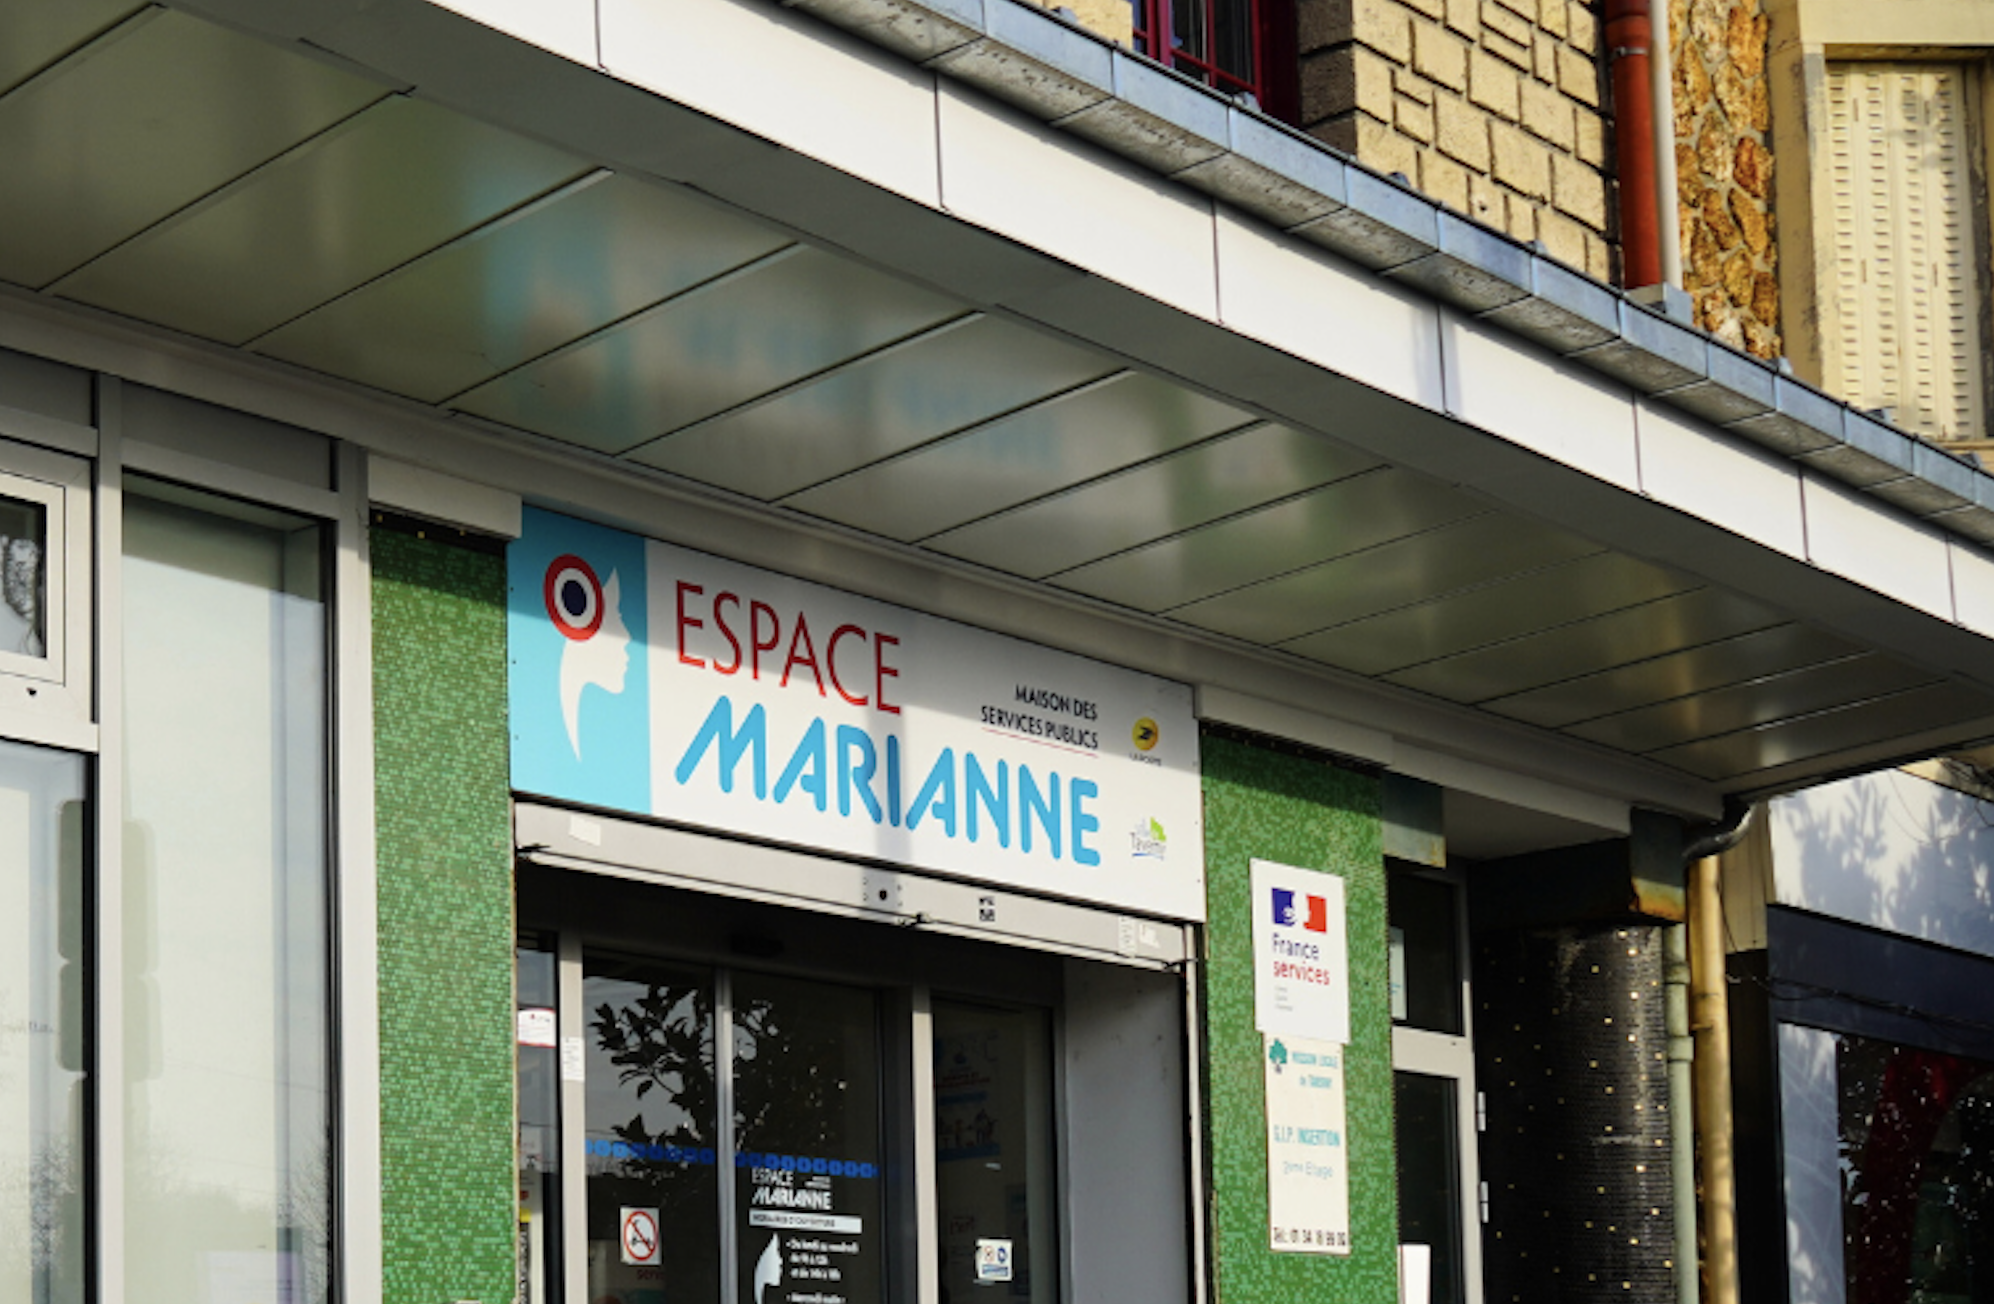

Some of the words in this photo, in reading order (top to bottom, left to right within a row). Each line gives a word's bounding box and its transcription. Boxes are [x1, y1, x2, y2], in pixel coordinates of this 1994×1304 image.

[676, 580, 902, 715] ESPACE
[1015, 684, 1070, 713] MAISON
[1074, 699, 1098, 721] DES
[981, 705, 1043, 736] SERVICES
[1045, 720, 1099, 750] PUBLICS
[674, 695, 1101, 867] MARIANNE
[1272, 932, 1319, 960] France
[1273, 960, 1330, 986] services
[1297, 1127, 1341, 1147] INSERTION
[751, 1166, 794, 1187] ESPACE
[752, 1186, 832, 1210] MARIANNE
